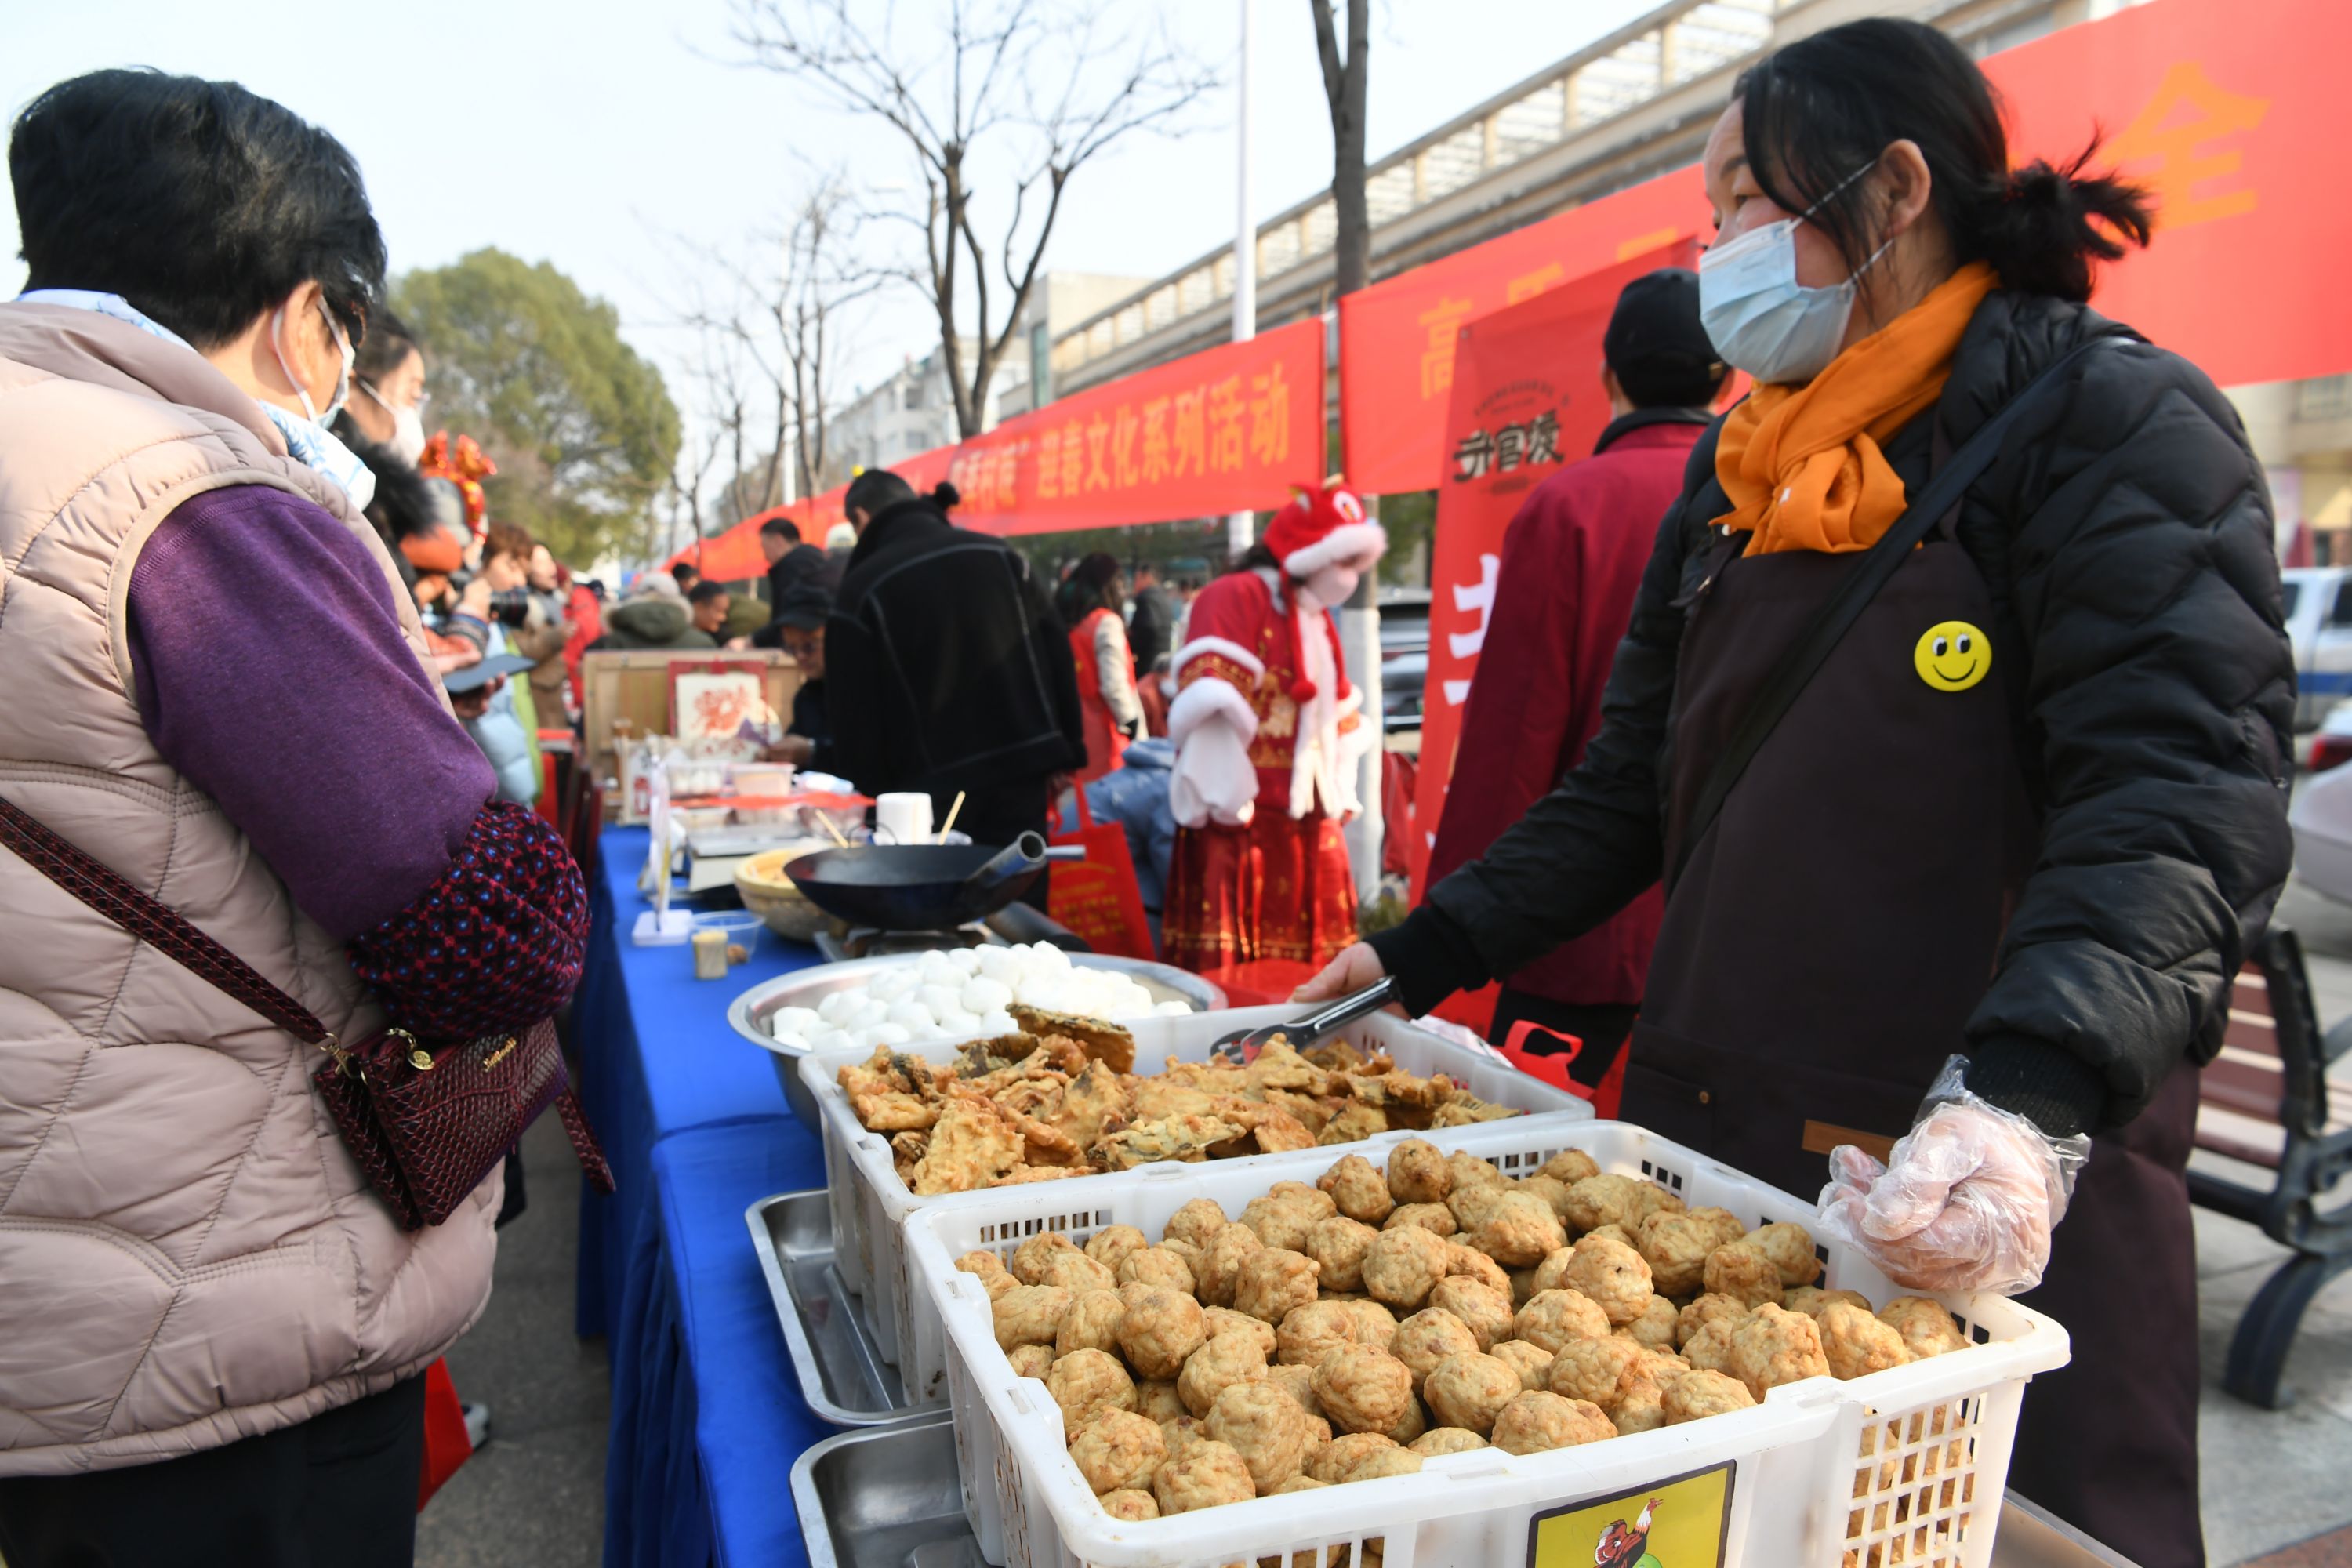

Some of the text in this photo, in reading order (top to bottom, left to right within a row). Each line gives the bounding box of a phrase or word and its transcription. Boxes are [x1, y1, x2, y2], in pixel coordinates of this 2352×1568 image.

[1036, 360, 1290, 500] 迎春文化系列活动
